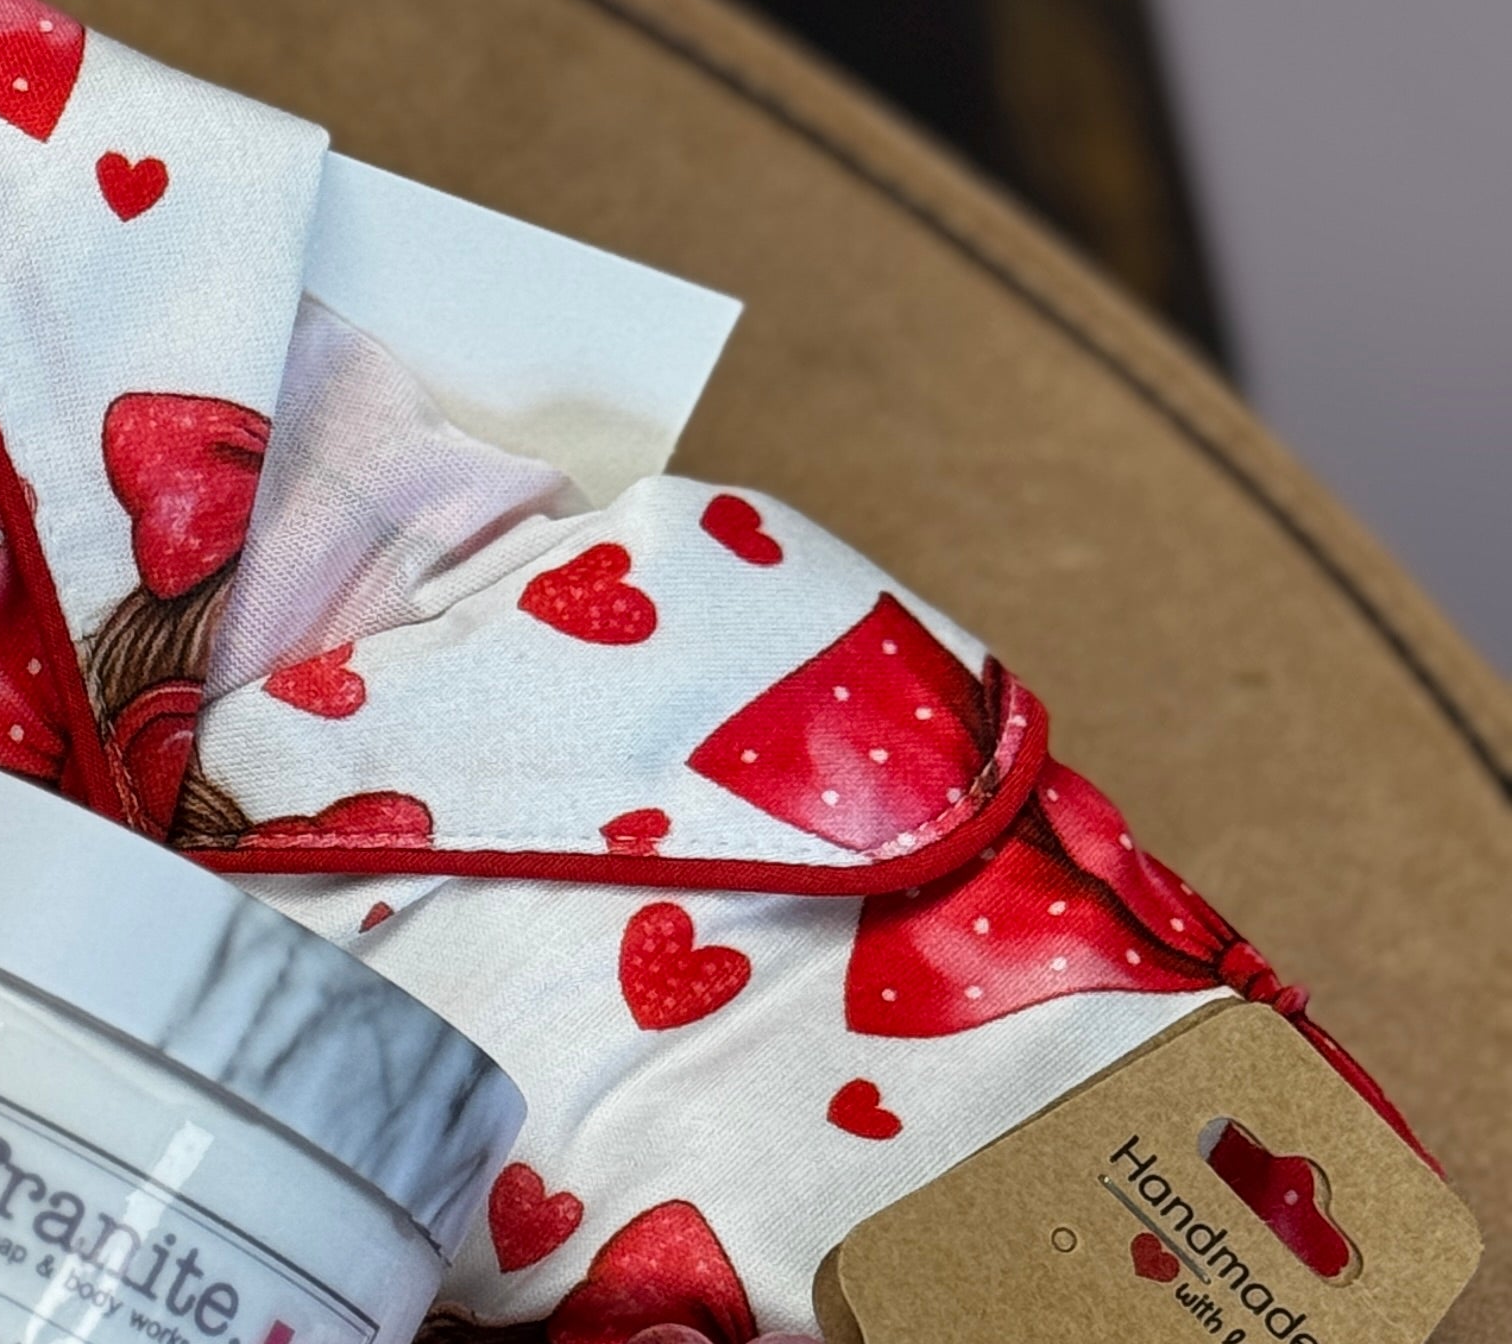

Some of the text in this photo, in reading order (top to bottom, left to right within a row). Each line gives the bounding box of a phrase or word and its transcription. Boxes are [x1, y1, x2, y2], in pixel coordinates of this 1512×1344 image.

[35, 1254, 56, 1280] &
[65, 1268, 125, 1316] body
[1174, 1282, 1224, 1335] with
